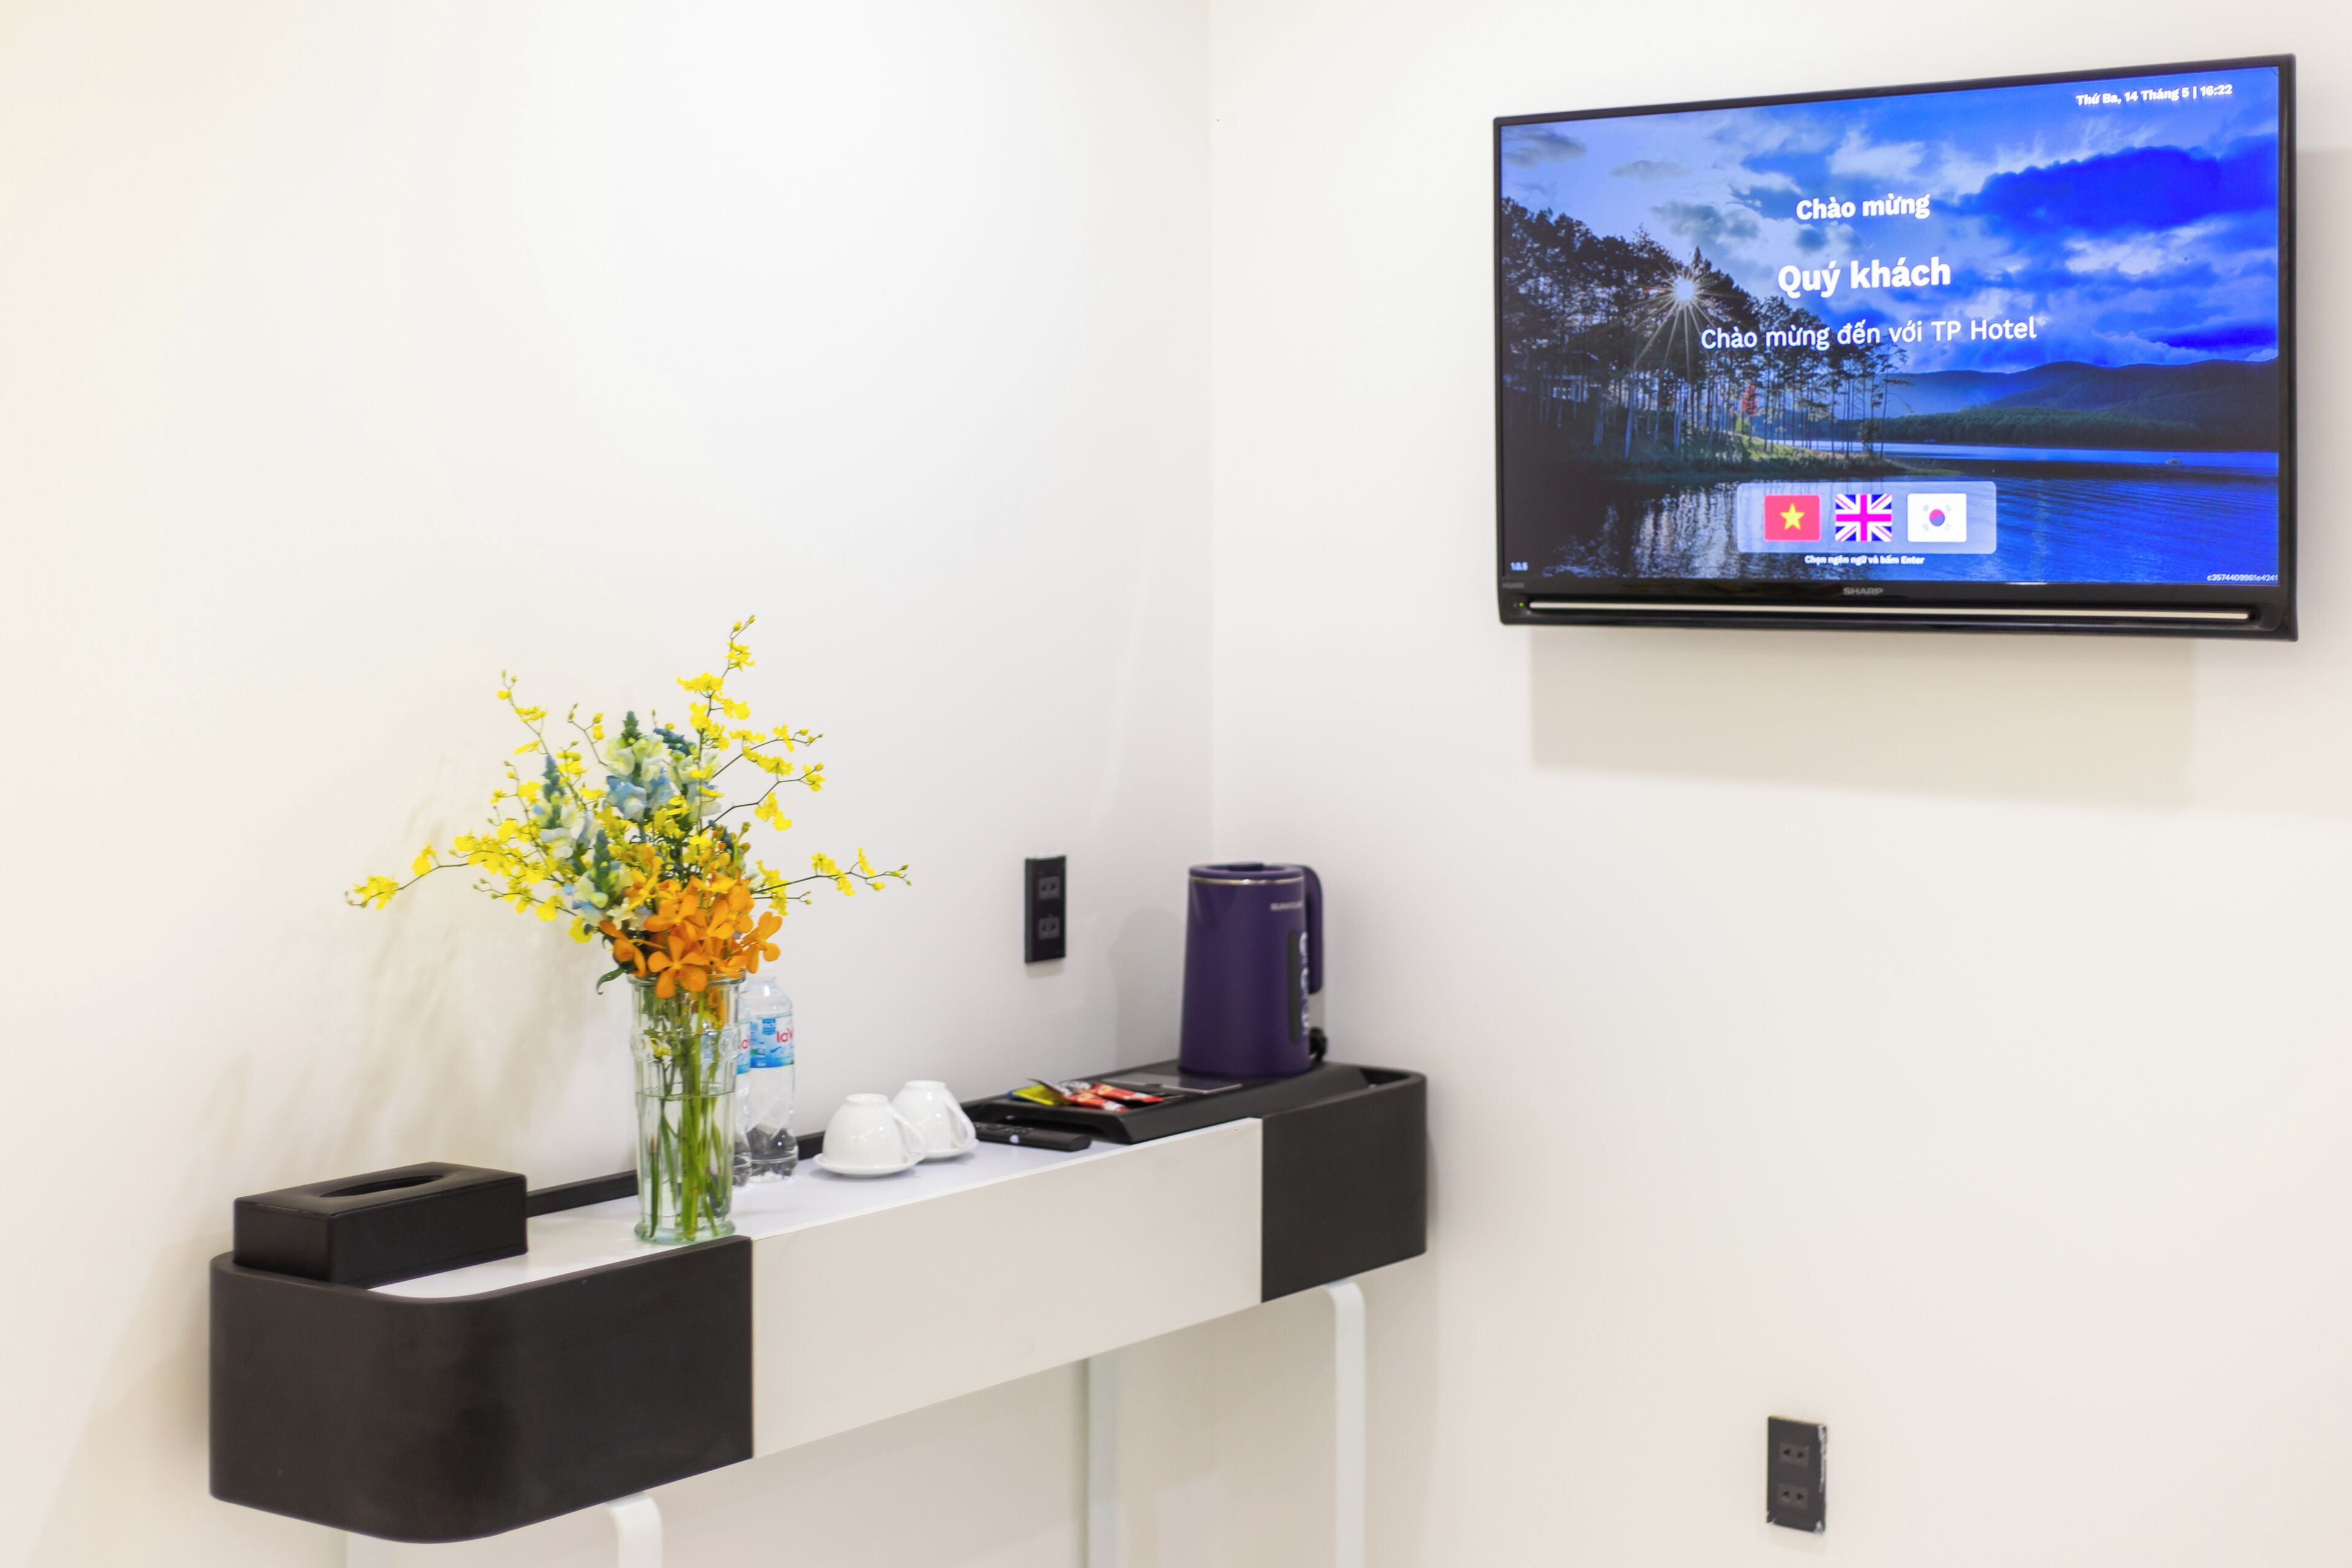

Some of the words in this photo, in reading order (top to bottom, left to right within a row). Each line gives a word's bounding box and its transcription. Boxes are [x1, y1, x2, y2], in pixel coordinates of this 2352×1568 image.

[2075, 92, 2100, 105] Thứ
[2102, 92, 2122, 105] Ba,
[2124, 91, 2139, 102] 14
[2141, 88, 2179, 102] Tháng
[2182, 87, 2190, 98] 5
[2200, 84, 2233, 97] 16:22
[1796, 196, 1856, 221] Chào
[1862, 193, 1931, 219] mừng
[1777, 260, 1841, 299] Quý
[1850, 256, 1951, 289] khách
[1701, 326, 1758, 350] Chào
[1766, 324, 1831, 351] mừng
[1837, 318, 1880, 345] đến
[1888, 319, 1923, 343] với
[1931, 320, 1961, 342] TP
[1971, 315, 2038, 341] Hotel
[1804, 554, 1827, 566] Chọn
[1868, 555, 1879, 565] và
[1901, 556, 1926, 565] Enter
[1842, 587, 1884, 595] SHARP
